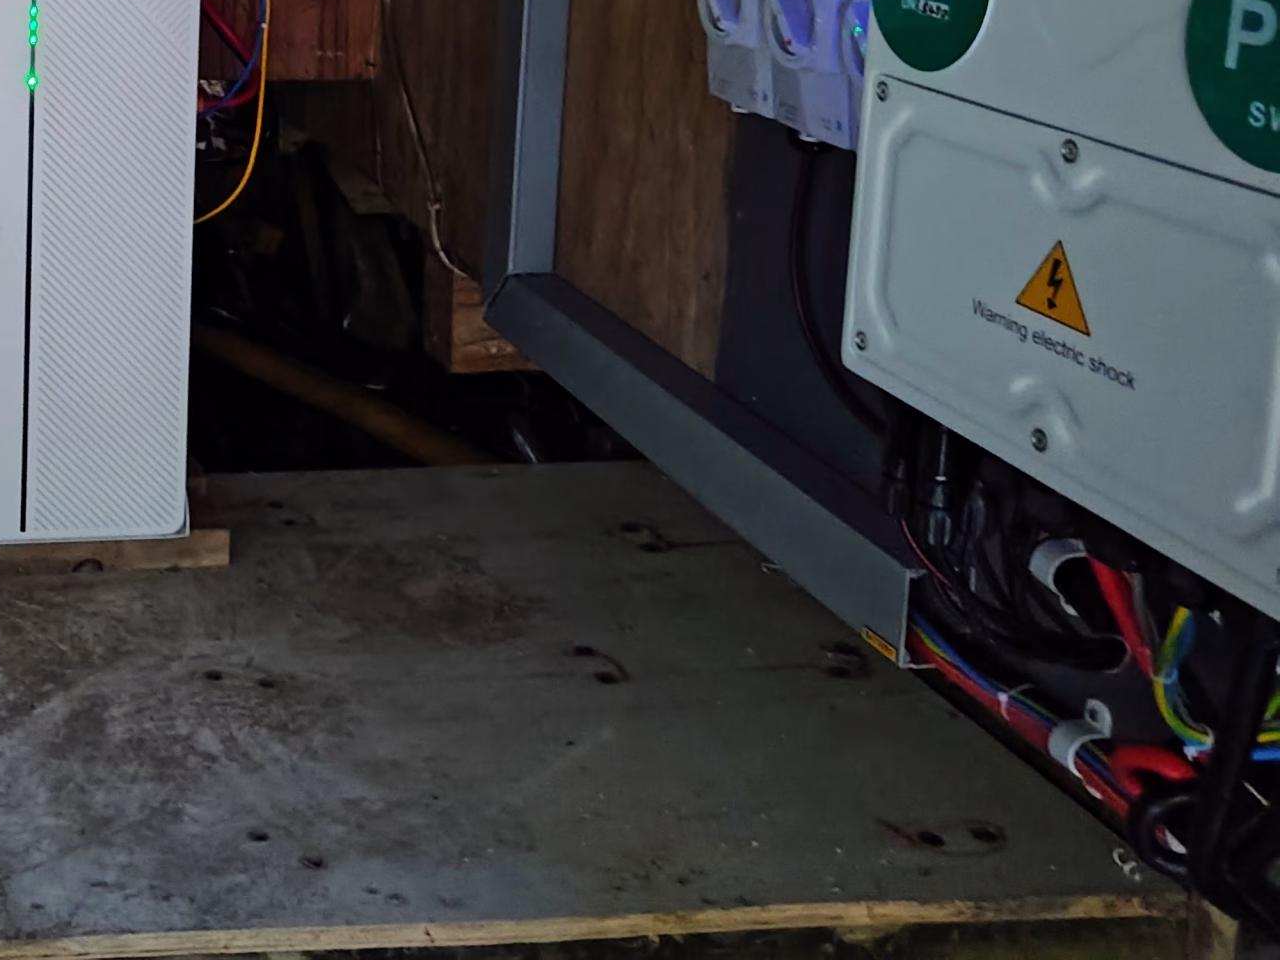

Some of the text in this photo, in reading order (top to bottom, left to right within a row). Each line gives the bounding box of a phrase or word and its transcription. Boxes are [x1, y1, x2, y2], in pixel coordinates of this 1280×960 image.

[971, 297, 1136, 391] Warning electric shock
